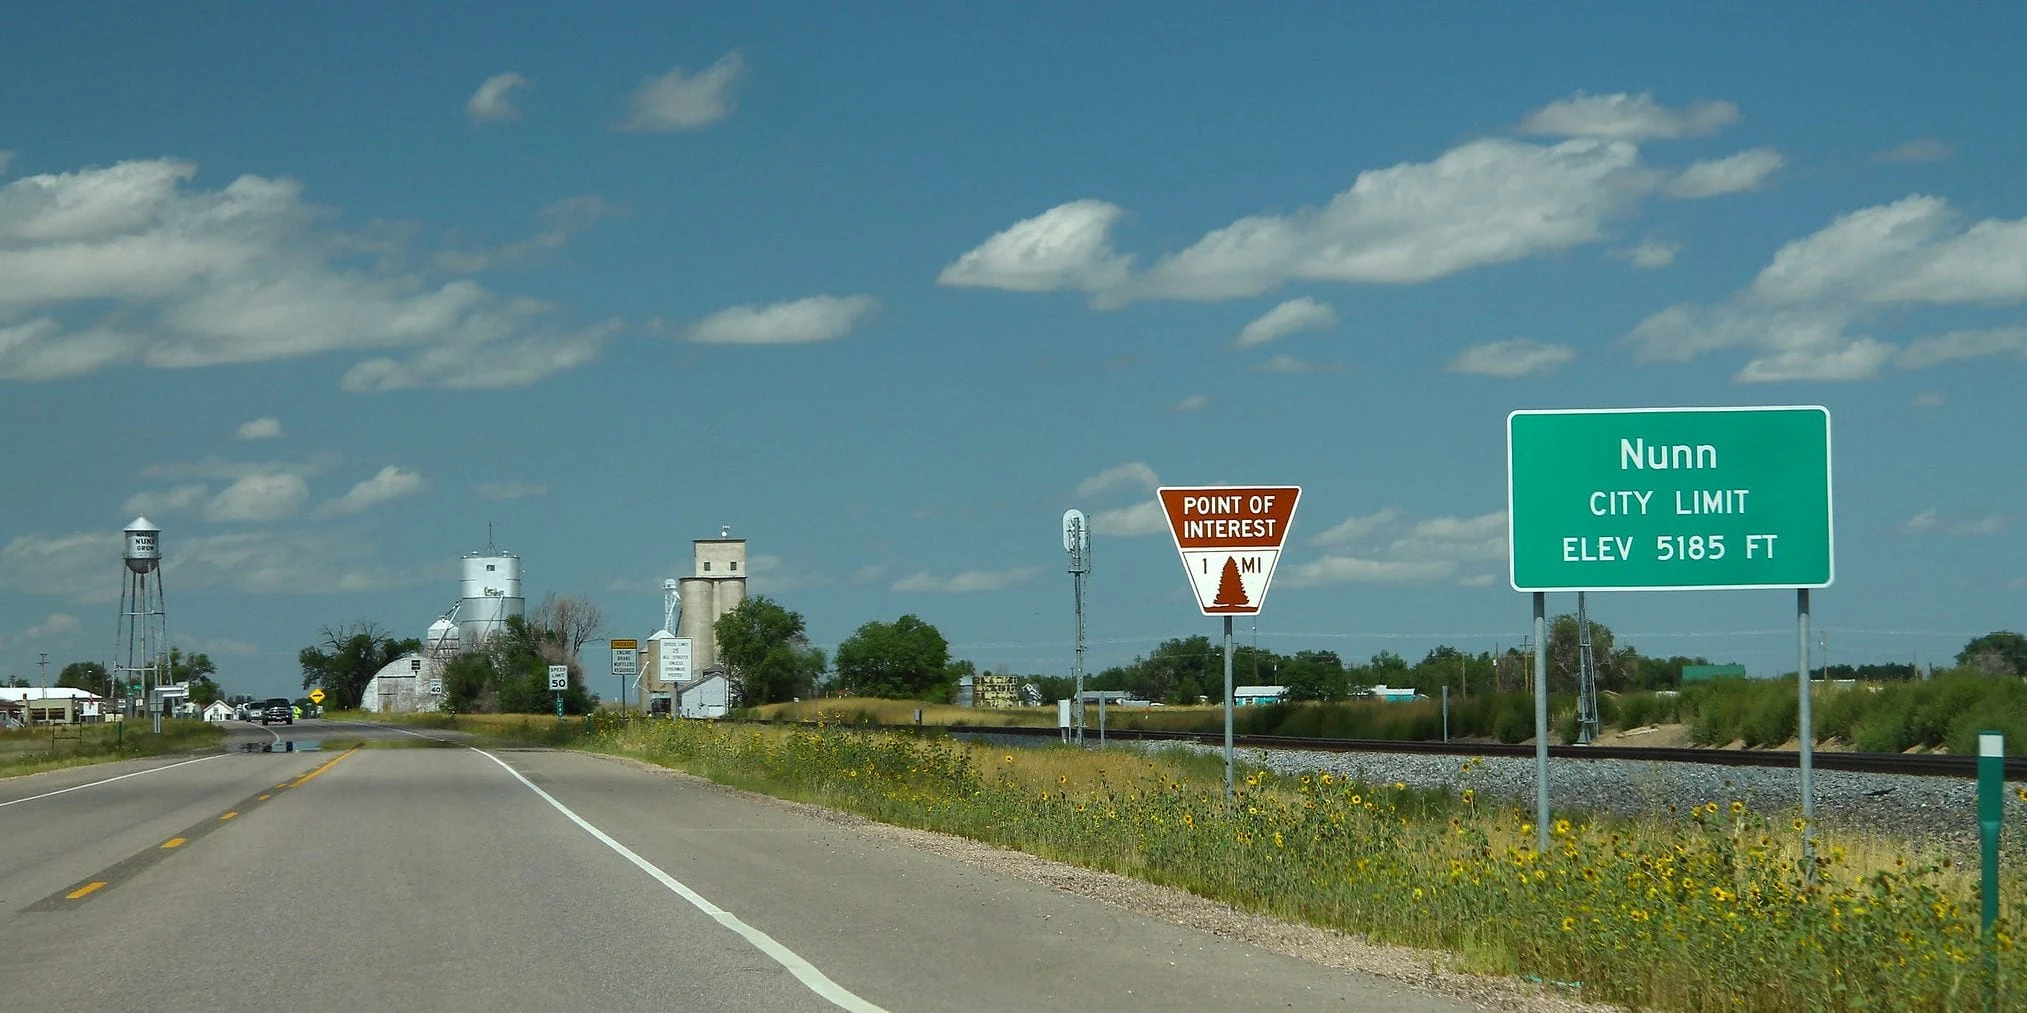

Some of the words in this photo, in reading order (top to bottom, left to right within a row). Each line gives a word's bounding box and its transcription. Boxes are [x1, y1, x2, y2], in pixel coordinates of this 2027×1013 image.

[1620, 438, 1717, 470] Nunn
[1184, 496, 1242, 515] POINT
[1249, 495, 1275, 514] OF
[1589, 491, 1653, 516] CITY
[1676, 489, 1749, 515] LIMIT
[1184, 519, 1276, 538] INTEREST
[1563, 536, 1634, 562] ELEV
[1657, 535, 1725, 561] 5185
[1746, 534, 1778, 559] FT
[1202, 558, 1207, 574] 1
[1242, 557, 1261, 573] MI
[552, 679, 566, 687] 50
